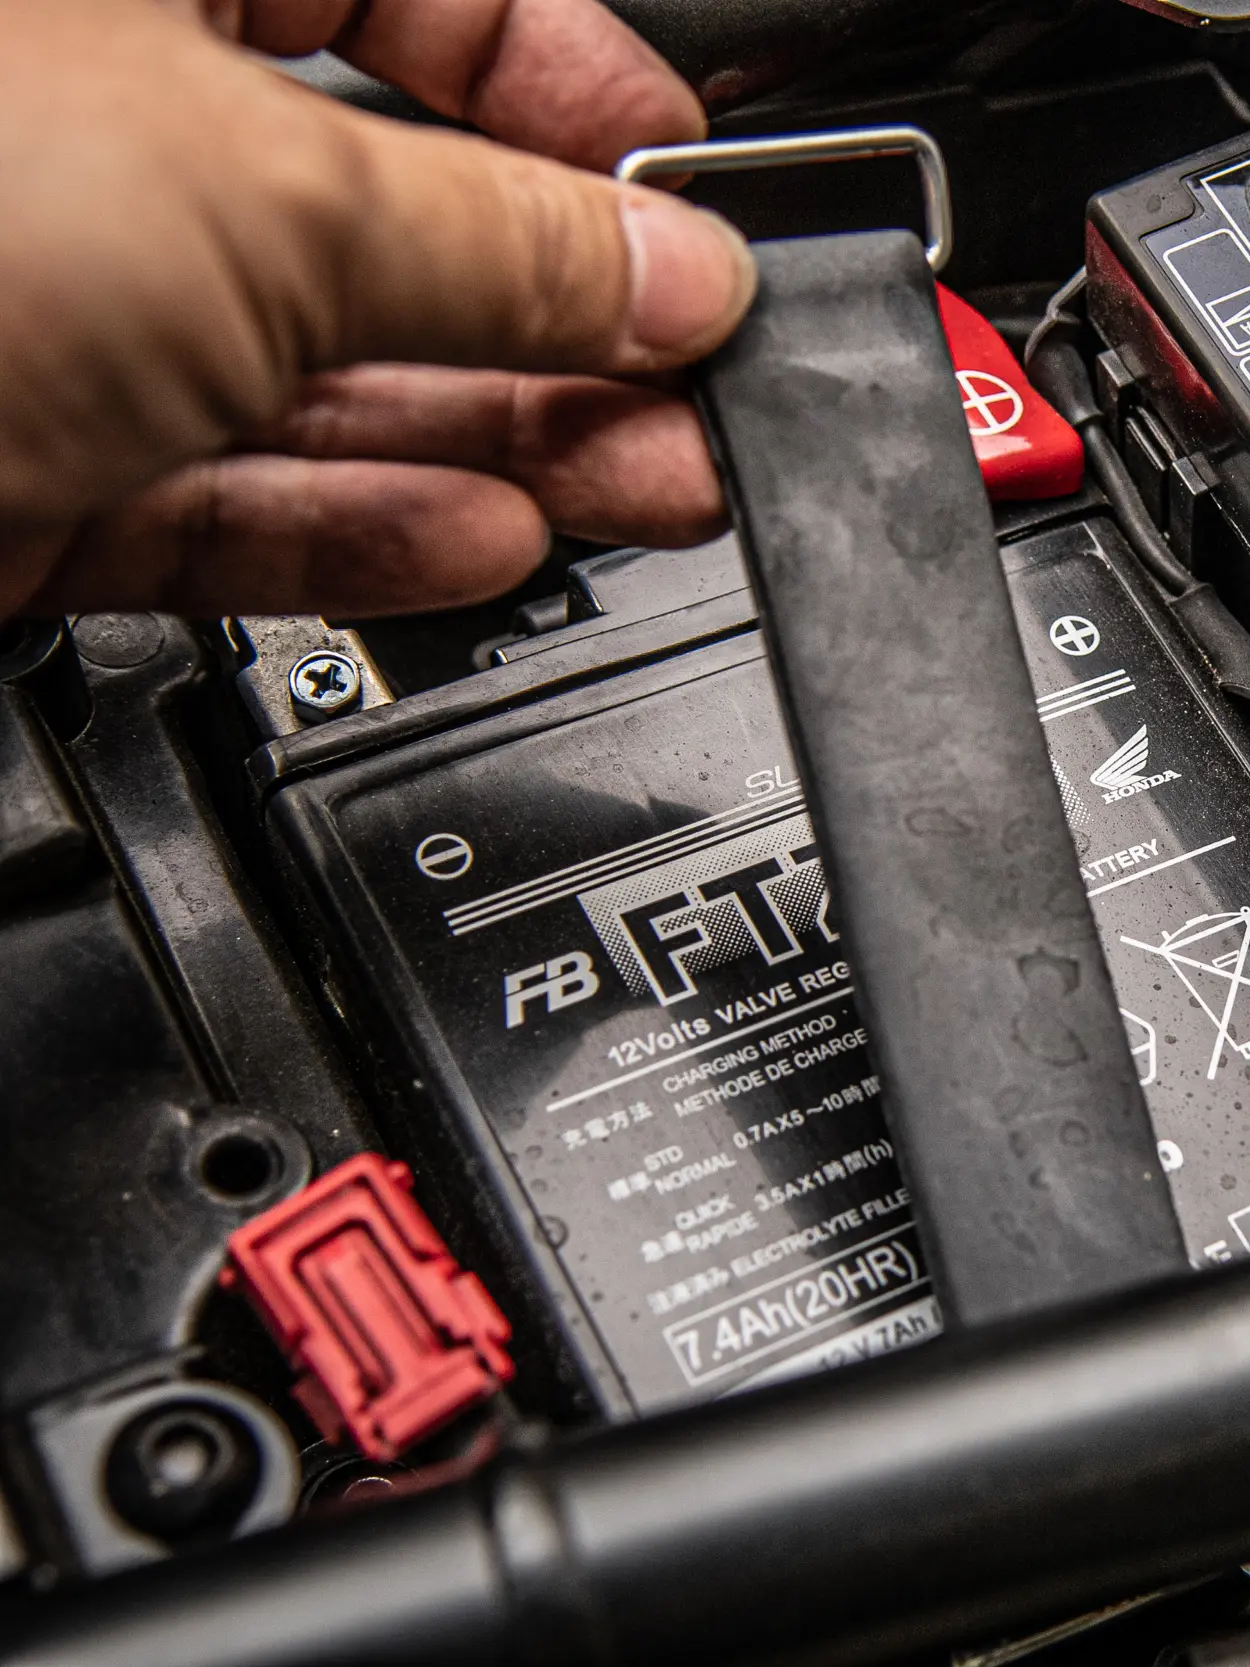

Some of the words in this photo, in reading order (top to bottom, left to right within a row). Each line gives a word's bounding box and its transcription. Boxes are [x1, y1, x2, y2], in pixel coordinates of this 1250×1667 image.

[1102, 769, 1182, 804] HONDA
[504, 950, 600, 1029] FB
[607, 1017, 711, 1068] 12Volts
[714, 981, 793, 1026] VALVE
[662, 1046, 759, 1093] CHARGING
[760, 1014, 836, 1053] METHOD
[674, 1066, 766, 1118] METHODE
[768, 1054, 794, 1079] DE
[794, 1028, 869, 1069] CHARGE
[644, 1145, 684, 1173] STD
[654, 1152, 738, 1196] NORMAL
[685, 1210, 760, 1254] RAPIDE
[676, 1240, 919, 1371] 7.4Ah(20HR)
